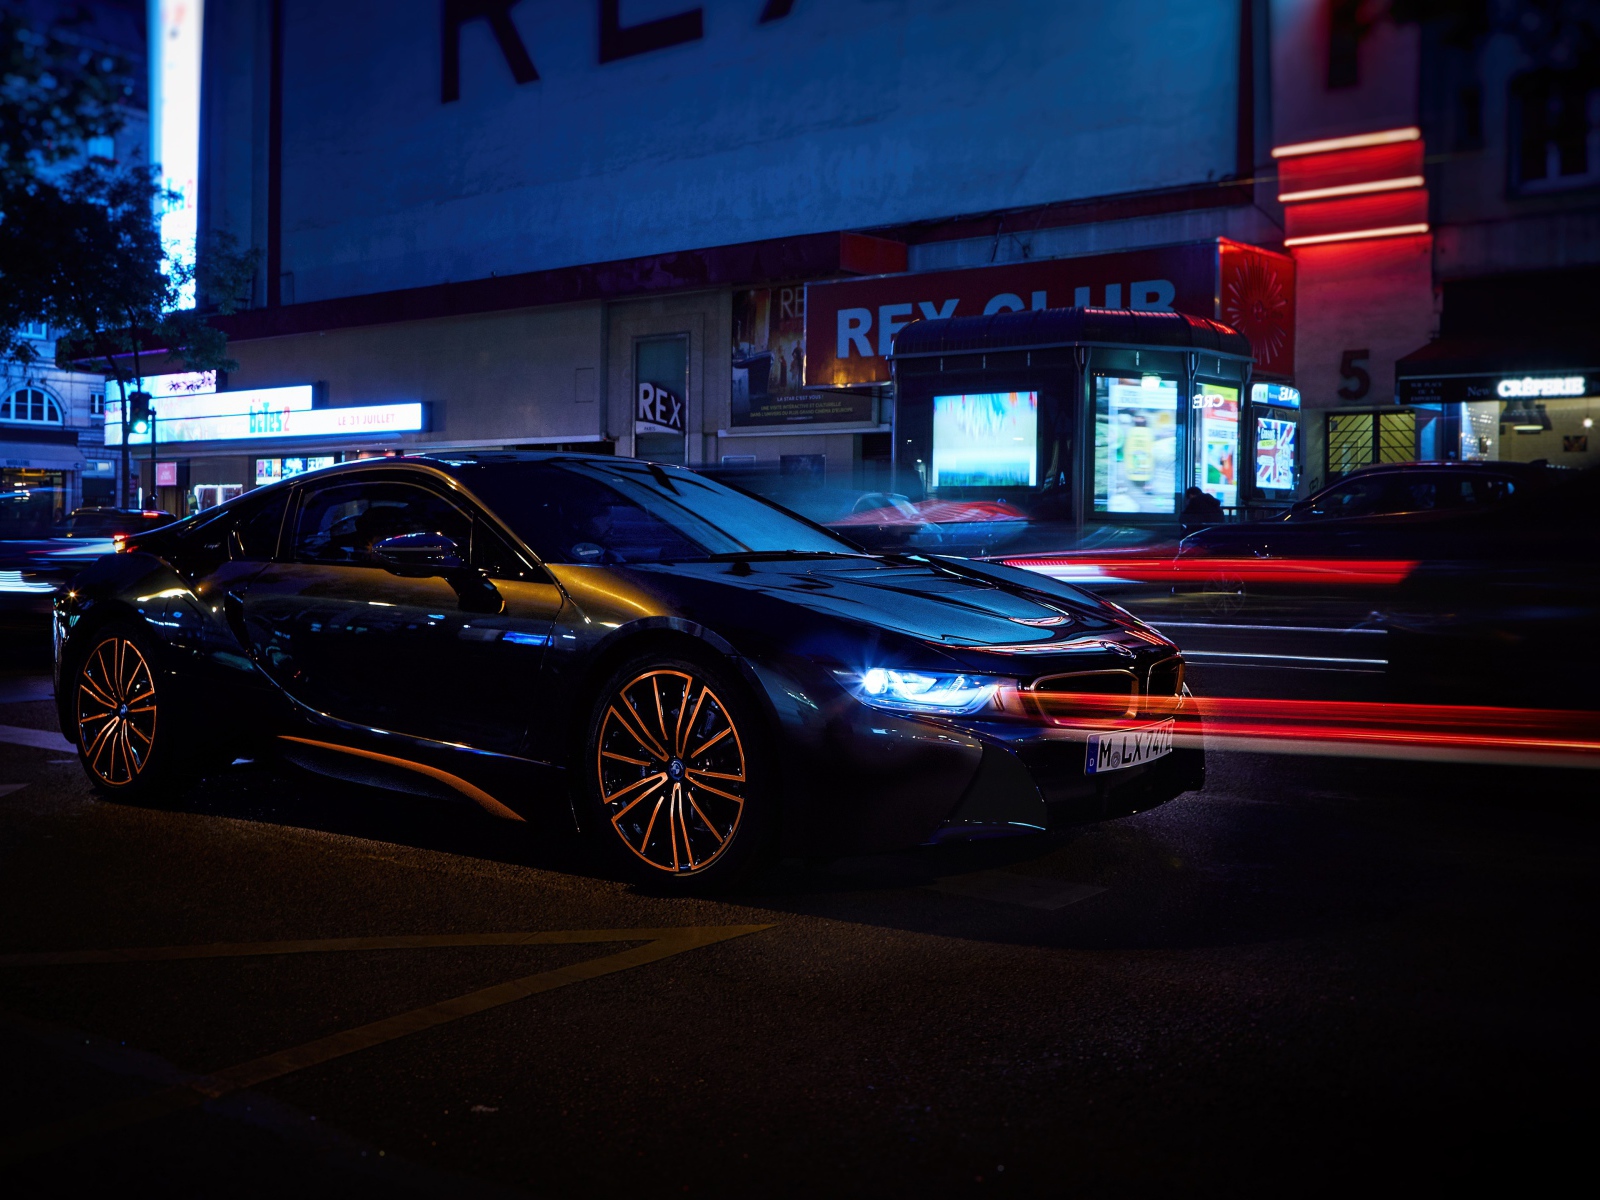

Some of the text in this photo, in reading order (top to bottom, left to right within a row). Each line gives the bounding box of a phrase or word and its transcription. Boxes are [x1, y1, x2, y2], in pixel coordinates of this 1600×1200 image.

[1338, 349, 1371, 399] 5
[338, 413, 396, 426] LE 31 JUILLET
[638, 382, 682, 428] REX
[1089, 758, 1095, 767] D
[1098, 738, 1112, 768] M
[1121, 732, 1143, 764] LX
